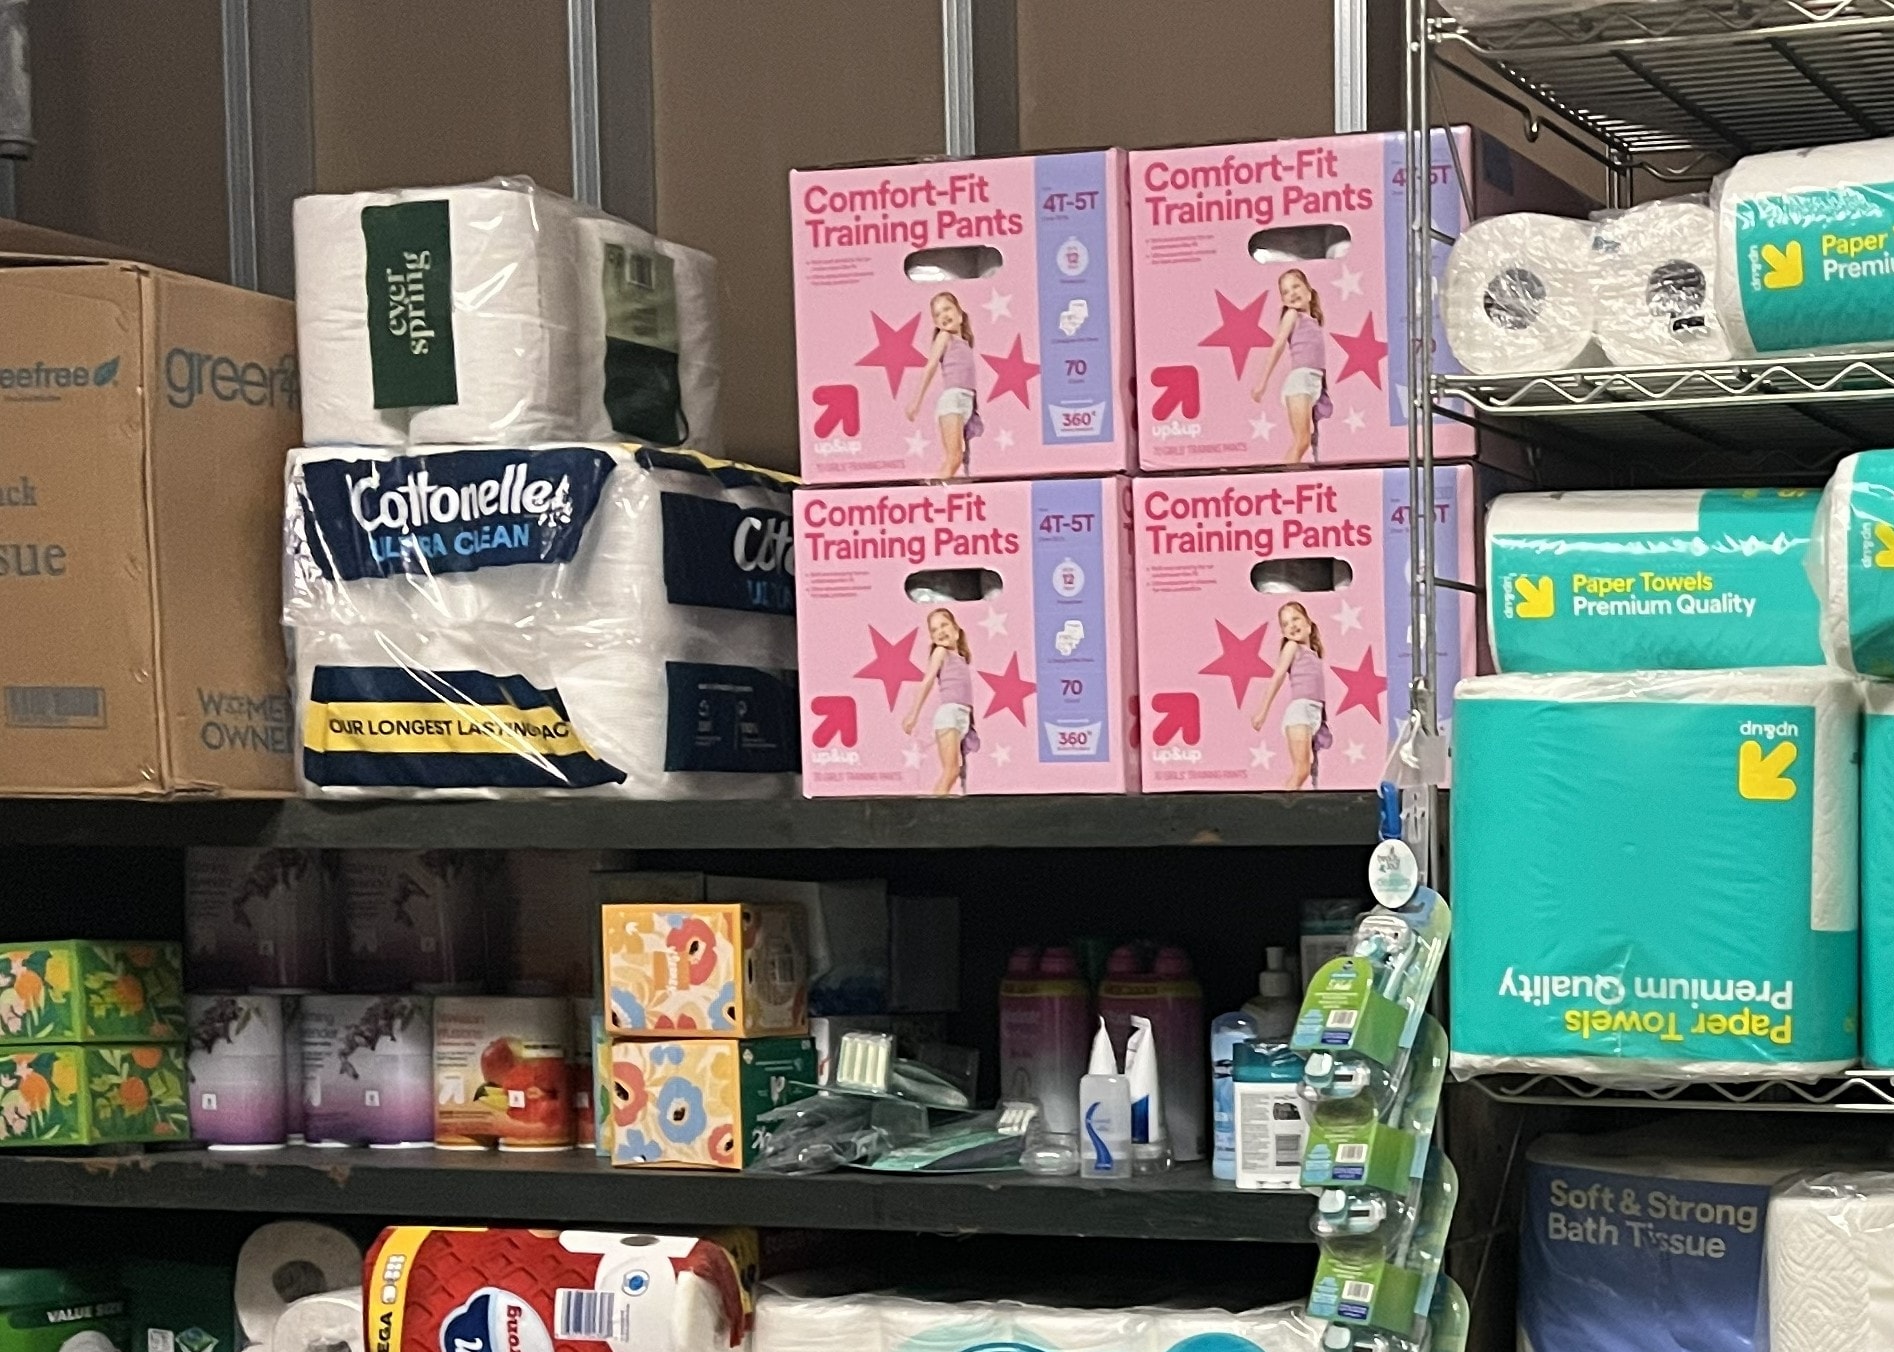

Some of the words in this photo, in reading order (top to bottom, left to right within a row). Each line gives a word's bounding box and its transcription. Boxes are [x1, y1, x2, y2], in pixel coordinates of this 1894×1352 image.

[1144, 147, 1338, 192] Comfort-Fit
[803, 173, 990, 215] Comfort-Fit
[1043, 191, 1099, 212] 4T-5T
[1145, 190, 1274, 225] Training
[1283, 183, 1373, 216] Pants
[805, 214, 929, 248] Training
[937, 208, 1023, 240] Pants
[1822, 233, 1888, 257] Paper
[387, 267, 410, 337] ever
[409, 250, 432, 355] spring
[1065, 358, 1087, 376] 70
[349, 463, 552, 531] Cottonelle
[804, 493, 987, 530] Comfort-Fit
[1038, 512, 1095, 535] 4T-5T
[1144, 484, 1338, 522] Comfort-Fit
[454, 523, 530, 555] CLEAN
[805, 527, 928, 564] Training
[933, 527, 1021, 557] Pants
[1145, 520, 1274, 557] Training
[1283, 518, 1373, 549] Pants
[1572, 573, 1636, 597] Paper
[1639, 570, 1714, 592] Towels
[1573, 593, 1672, 617] Premium
[1676, 592, 1757, 618] Quality
[1060, 679, 1084, 697] 70
[329, 717, 364, 736] OUR
[368, 718, 452, 737] LONGEST
[1739, 720, 1799, 739] up&up
[1500, 966, 1627, 1007] Quality
[1634, 975, 1794, 1010] Premium
[1565, 1008, 1684, 1042] Towels
[1691, 1007, 1794, 1045] Paper
[1549, 1178, 1614, 1212] Soft
[1621, 1187, 1643, 1216] &
[1648, 1190, 1759, 1234] Strong
[1548, 1211, 1618, 1245] Bath
[1625, 1221, 1727, 1260] Tissue
[47, 1307, 92, 1323] VALUE
